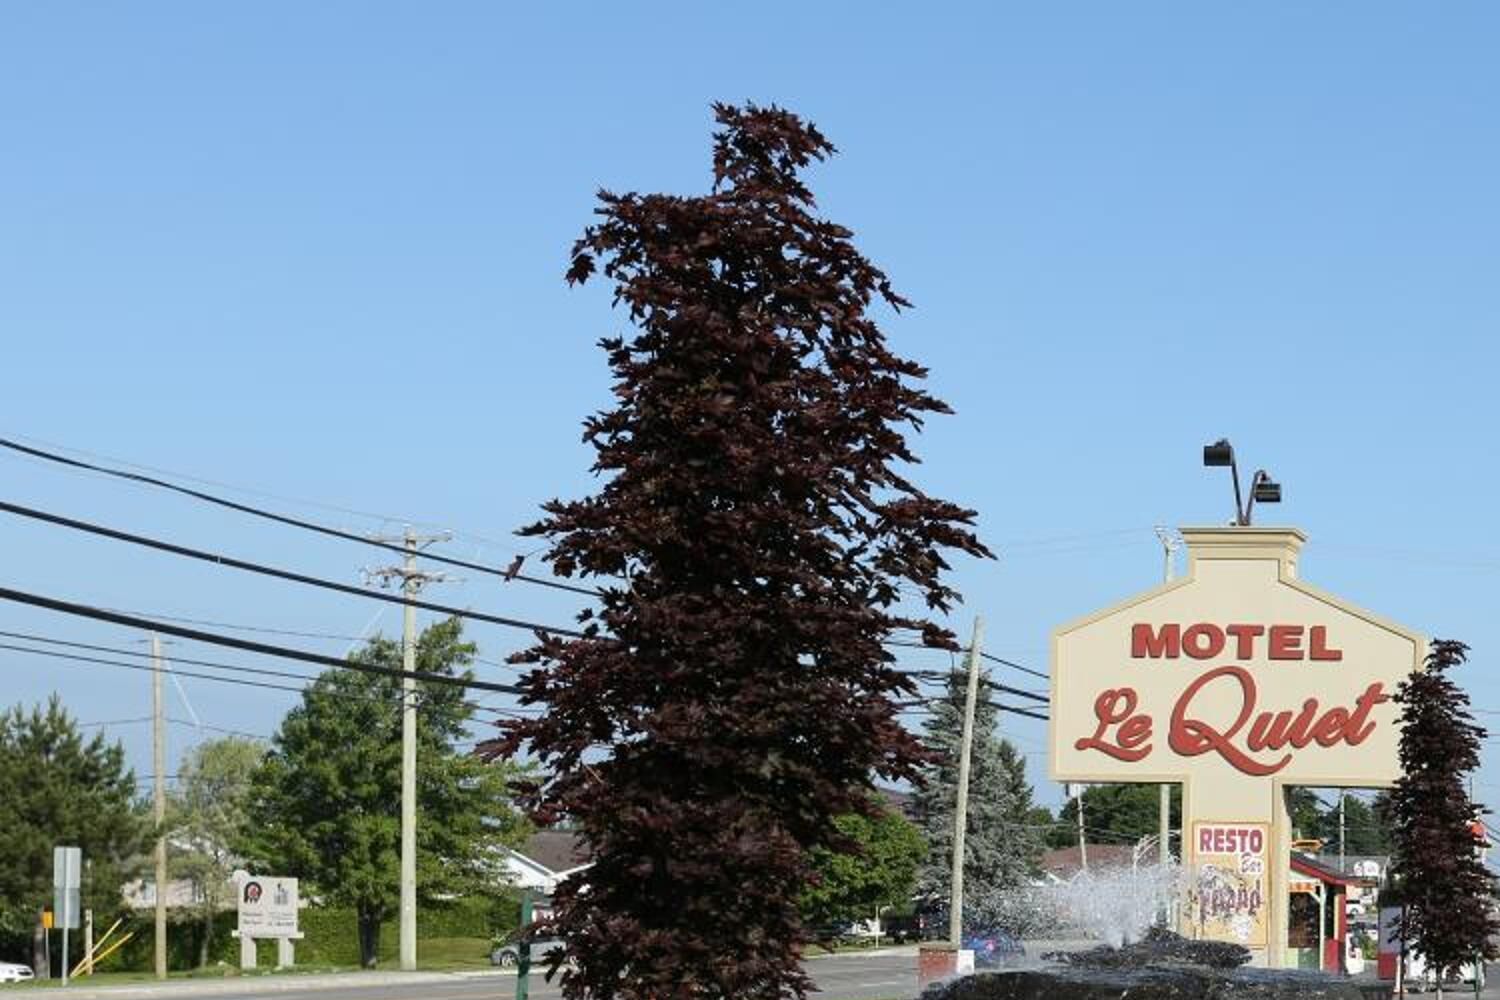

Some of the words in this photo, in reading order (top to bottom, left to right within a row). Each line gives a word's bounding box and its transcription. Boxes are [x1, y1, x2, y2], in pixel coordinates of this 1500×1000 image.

[1132, 624, 1342, 660] MOTEL
[1075, 687, 1153, 761] Le
[1169, 666, 1395, 776] Quiet
[1200, 828, 1263, 853] RESTO
